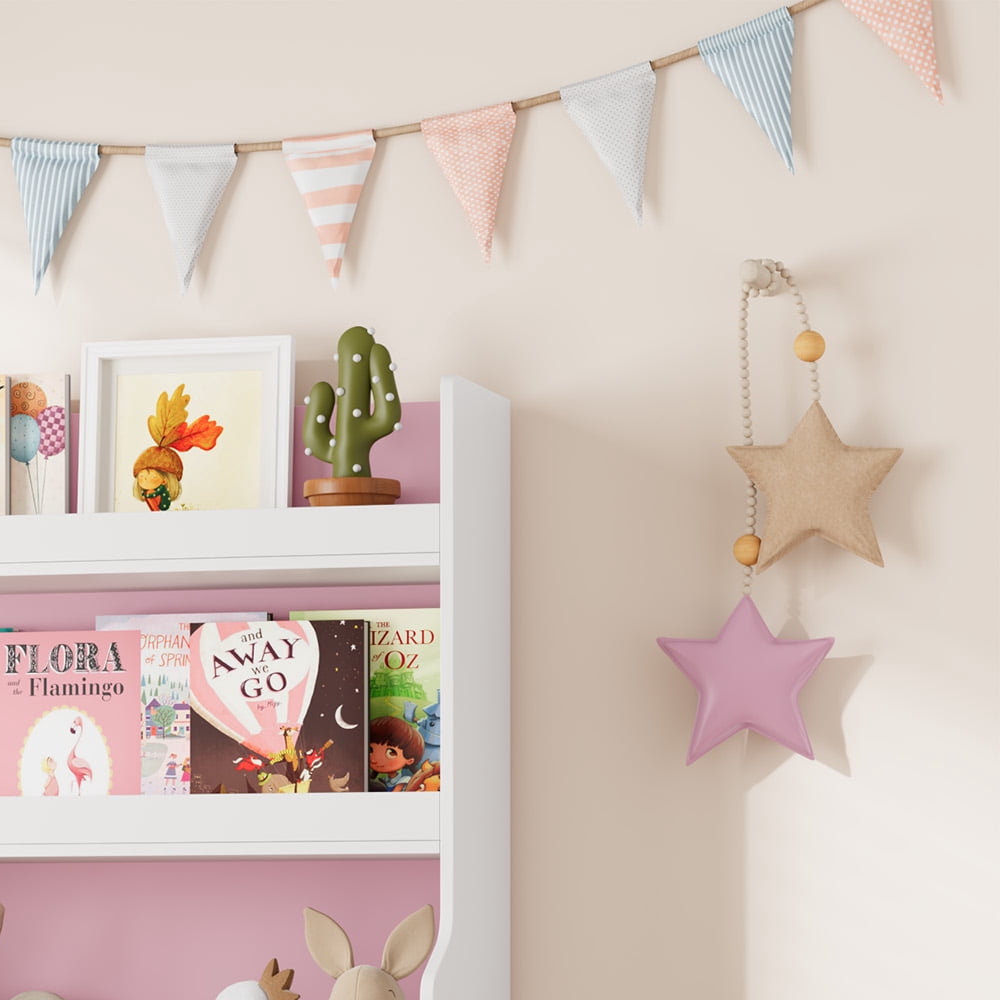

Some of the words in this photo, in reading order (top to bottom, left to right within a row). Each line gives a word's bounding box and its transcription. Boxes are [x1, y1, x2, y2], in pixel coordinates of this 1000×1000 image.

[241, 628, 263, 642] and
[370, 630, 434, 645] IZARD
[4, 642, 126, 674] FLORA
[212, 638, 301, 679] AWAY
[251, 665, 269, 675] we
[30, 677, 124, 702] Flamingo
[240, 672, 287, 698] GO
